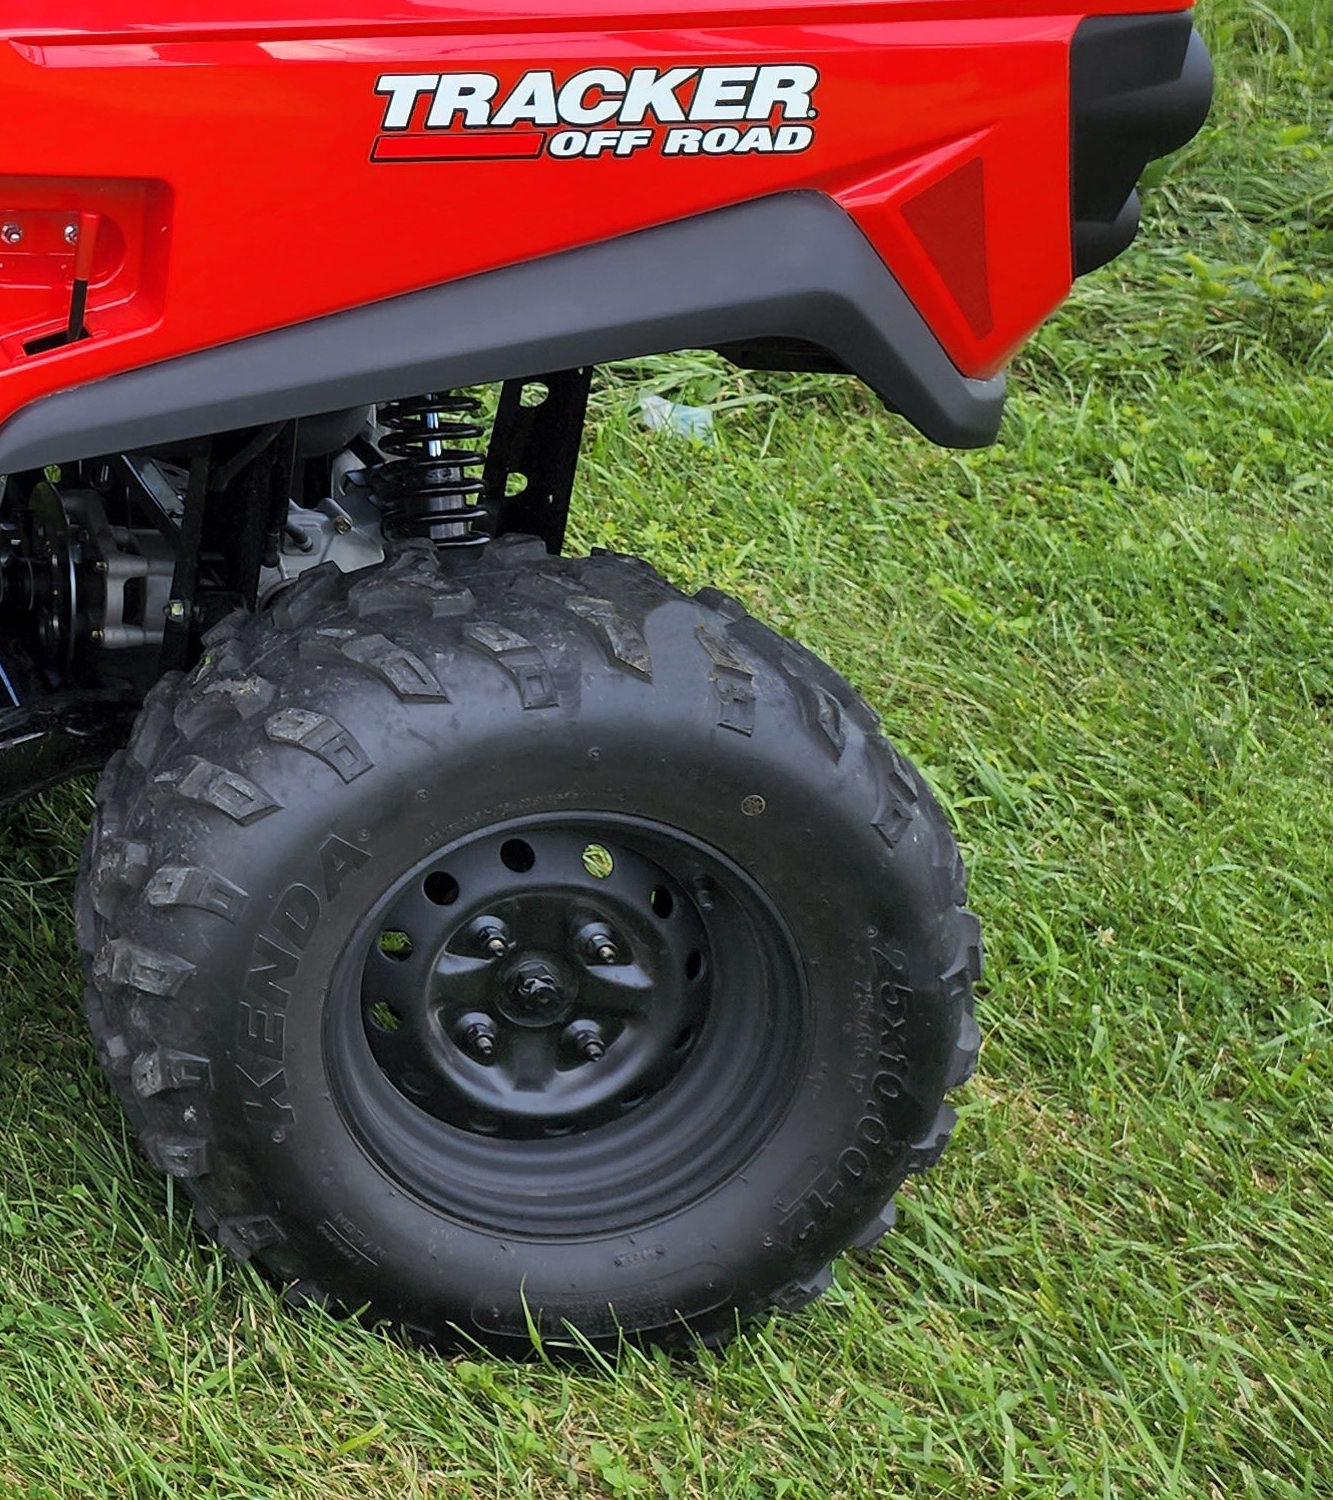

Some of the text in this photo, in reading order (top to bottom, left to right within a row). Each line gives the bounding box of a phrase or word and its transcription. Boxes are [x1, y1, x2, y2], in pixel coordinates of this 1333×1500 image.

[374, 64, 820, 129] TRACKER
[547, 126, 815, 158] OFF ROAD
[235, 834, 372, 1125] KENDA
